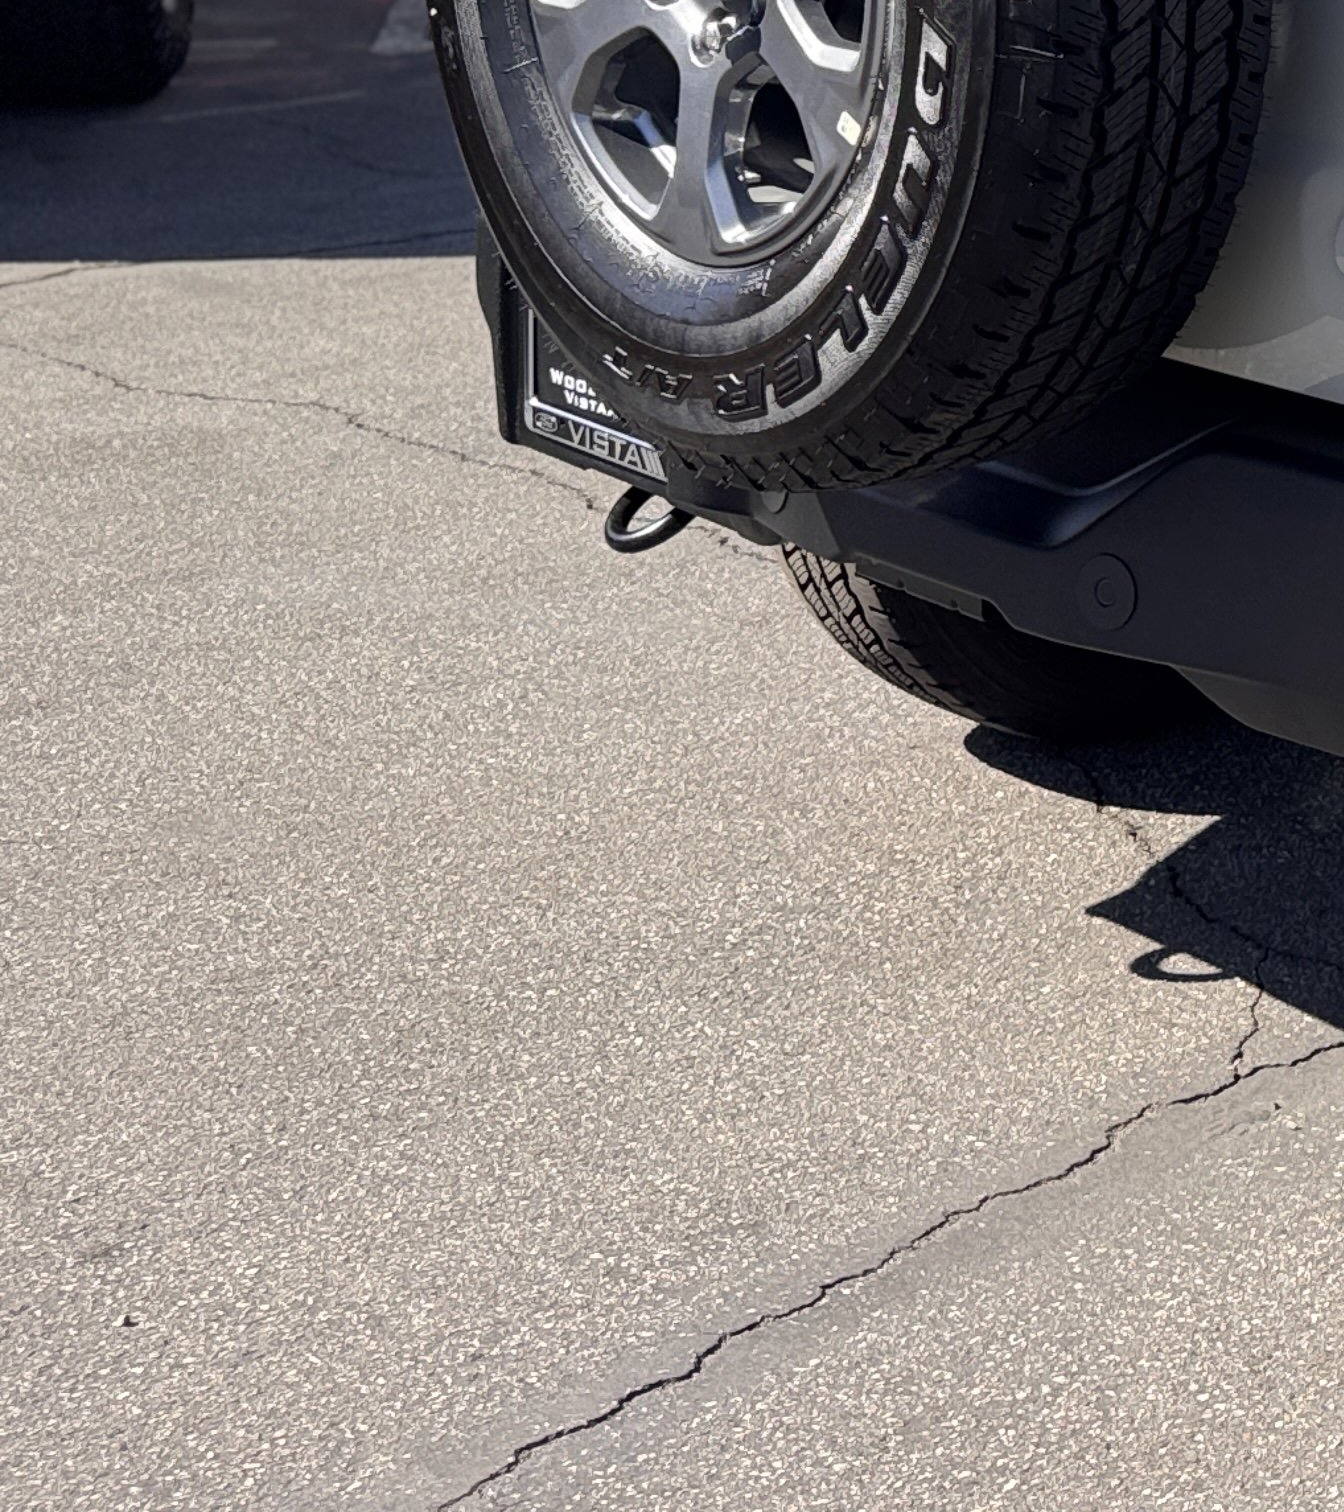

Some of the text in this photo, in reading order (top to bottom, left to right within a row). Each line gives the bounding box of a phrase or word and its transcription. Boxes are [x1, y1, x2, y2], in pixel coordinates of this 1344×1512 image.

[713, 6, 957, 423] DUELER
[602, 346, 693, 400] A/T
[567, 420, 644, 470] VISTA
